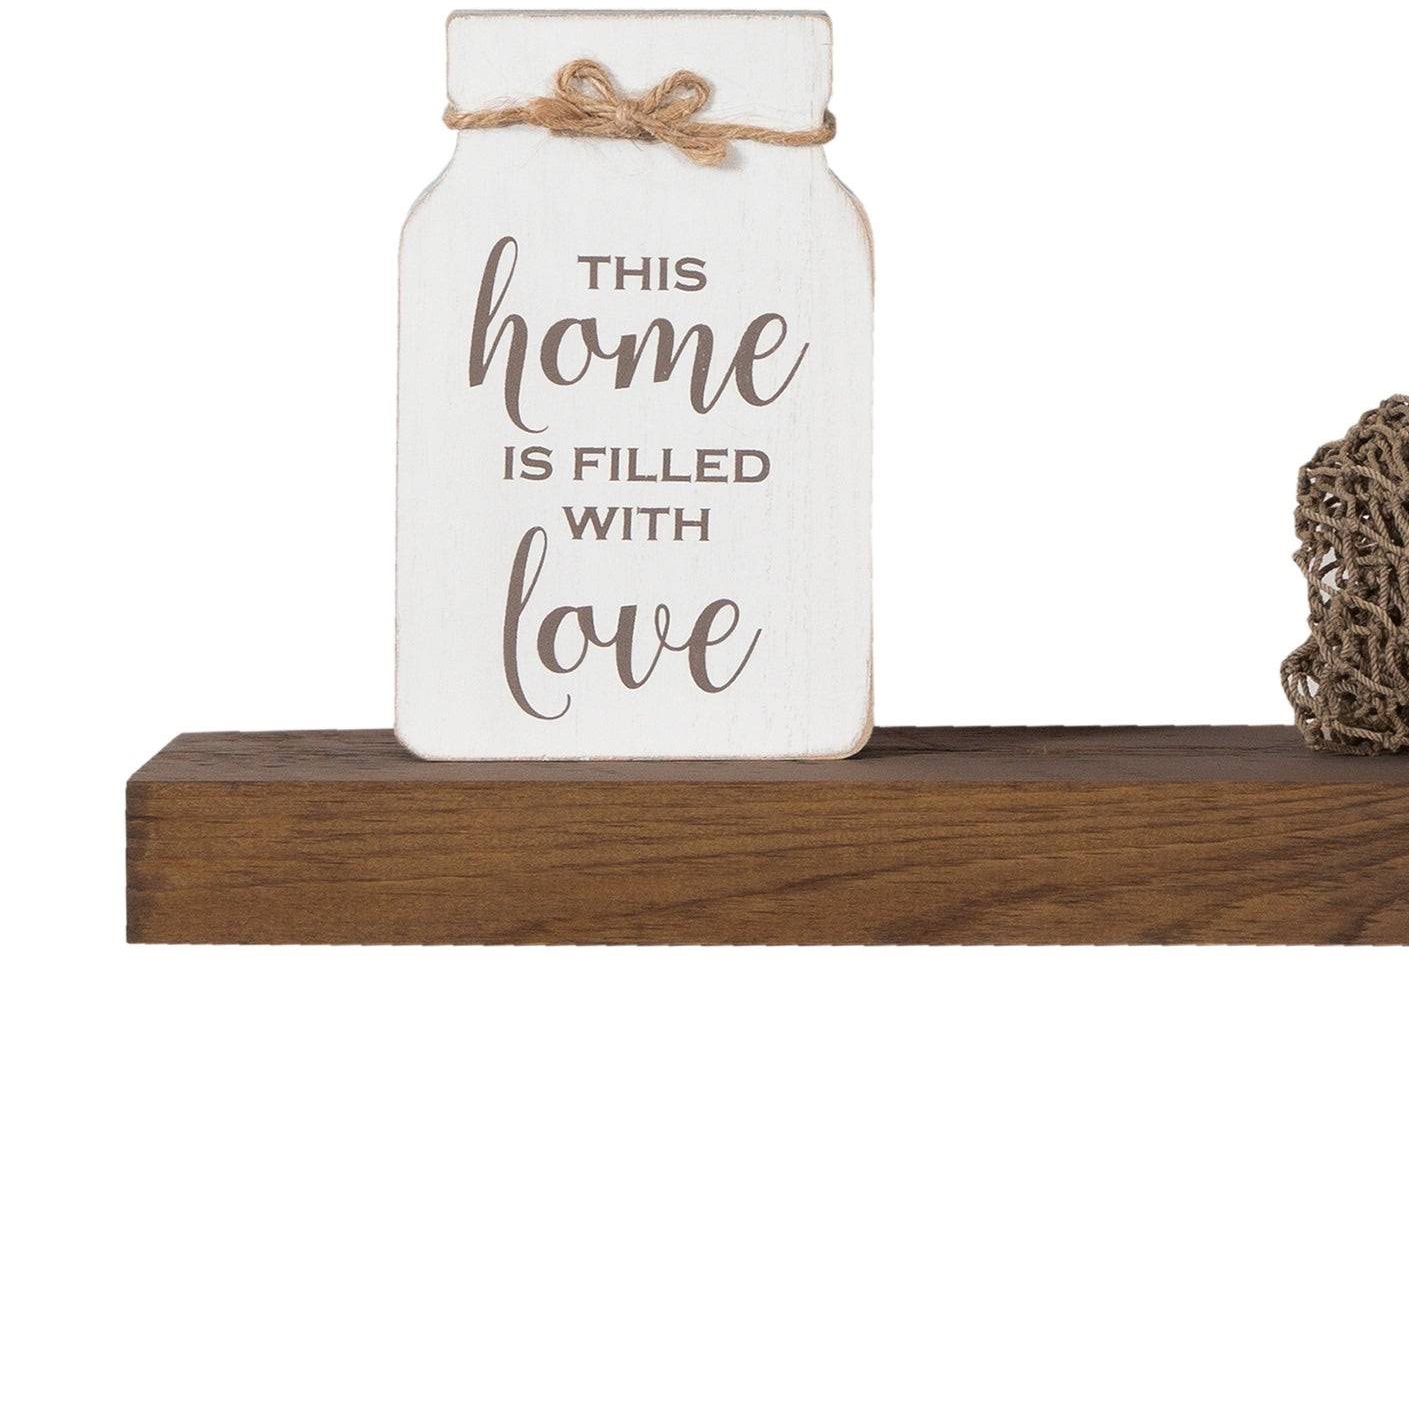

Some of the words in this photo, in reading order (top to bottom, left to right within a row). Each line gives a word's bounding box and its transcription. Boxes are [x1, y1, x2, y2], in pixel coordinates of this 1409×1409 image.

[578, 255, 707, 291] THIS
[468, 235, 810, 434] home
[503, 445, 554, 481] IS
[572, 446, 771, 483] FILLED
[562, 506, 711, 541] WITH
[503, 526, 763, 720] love
